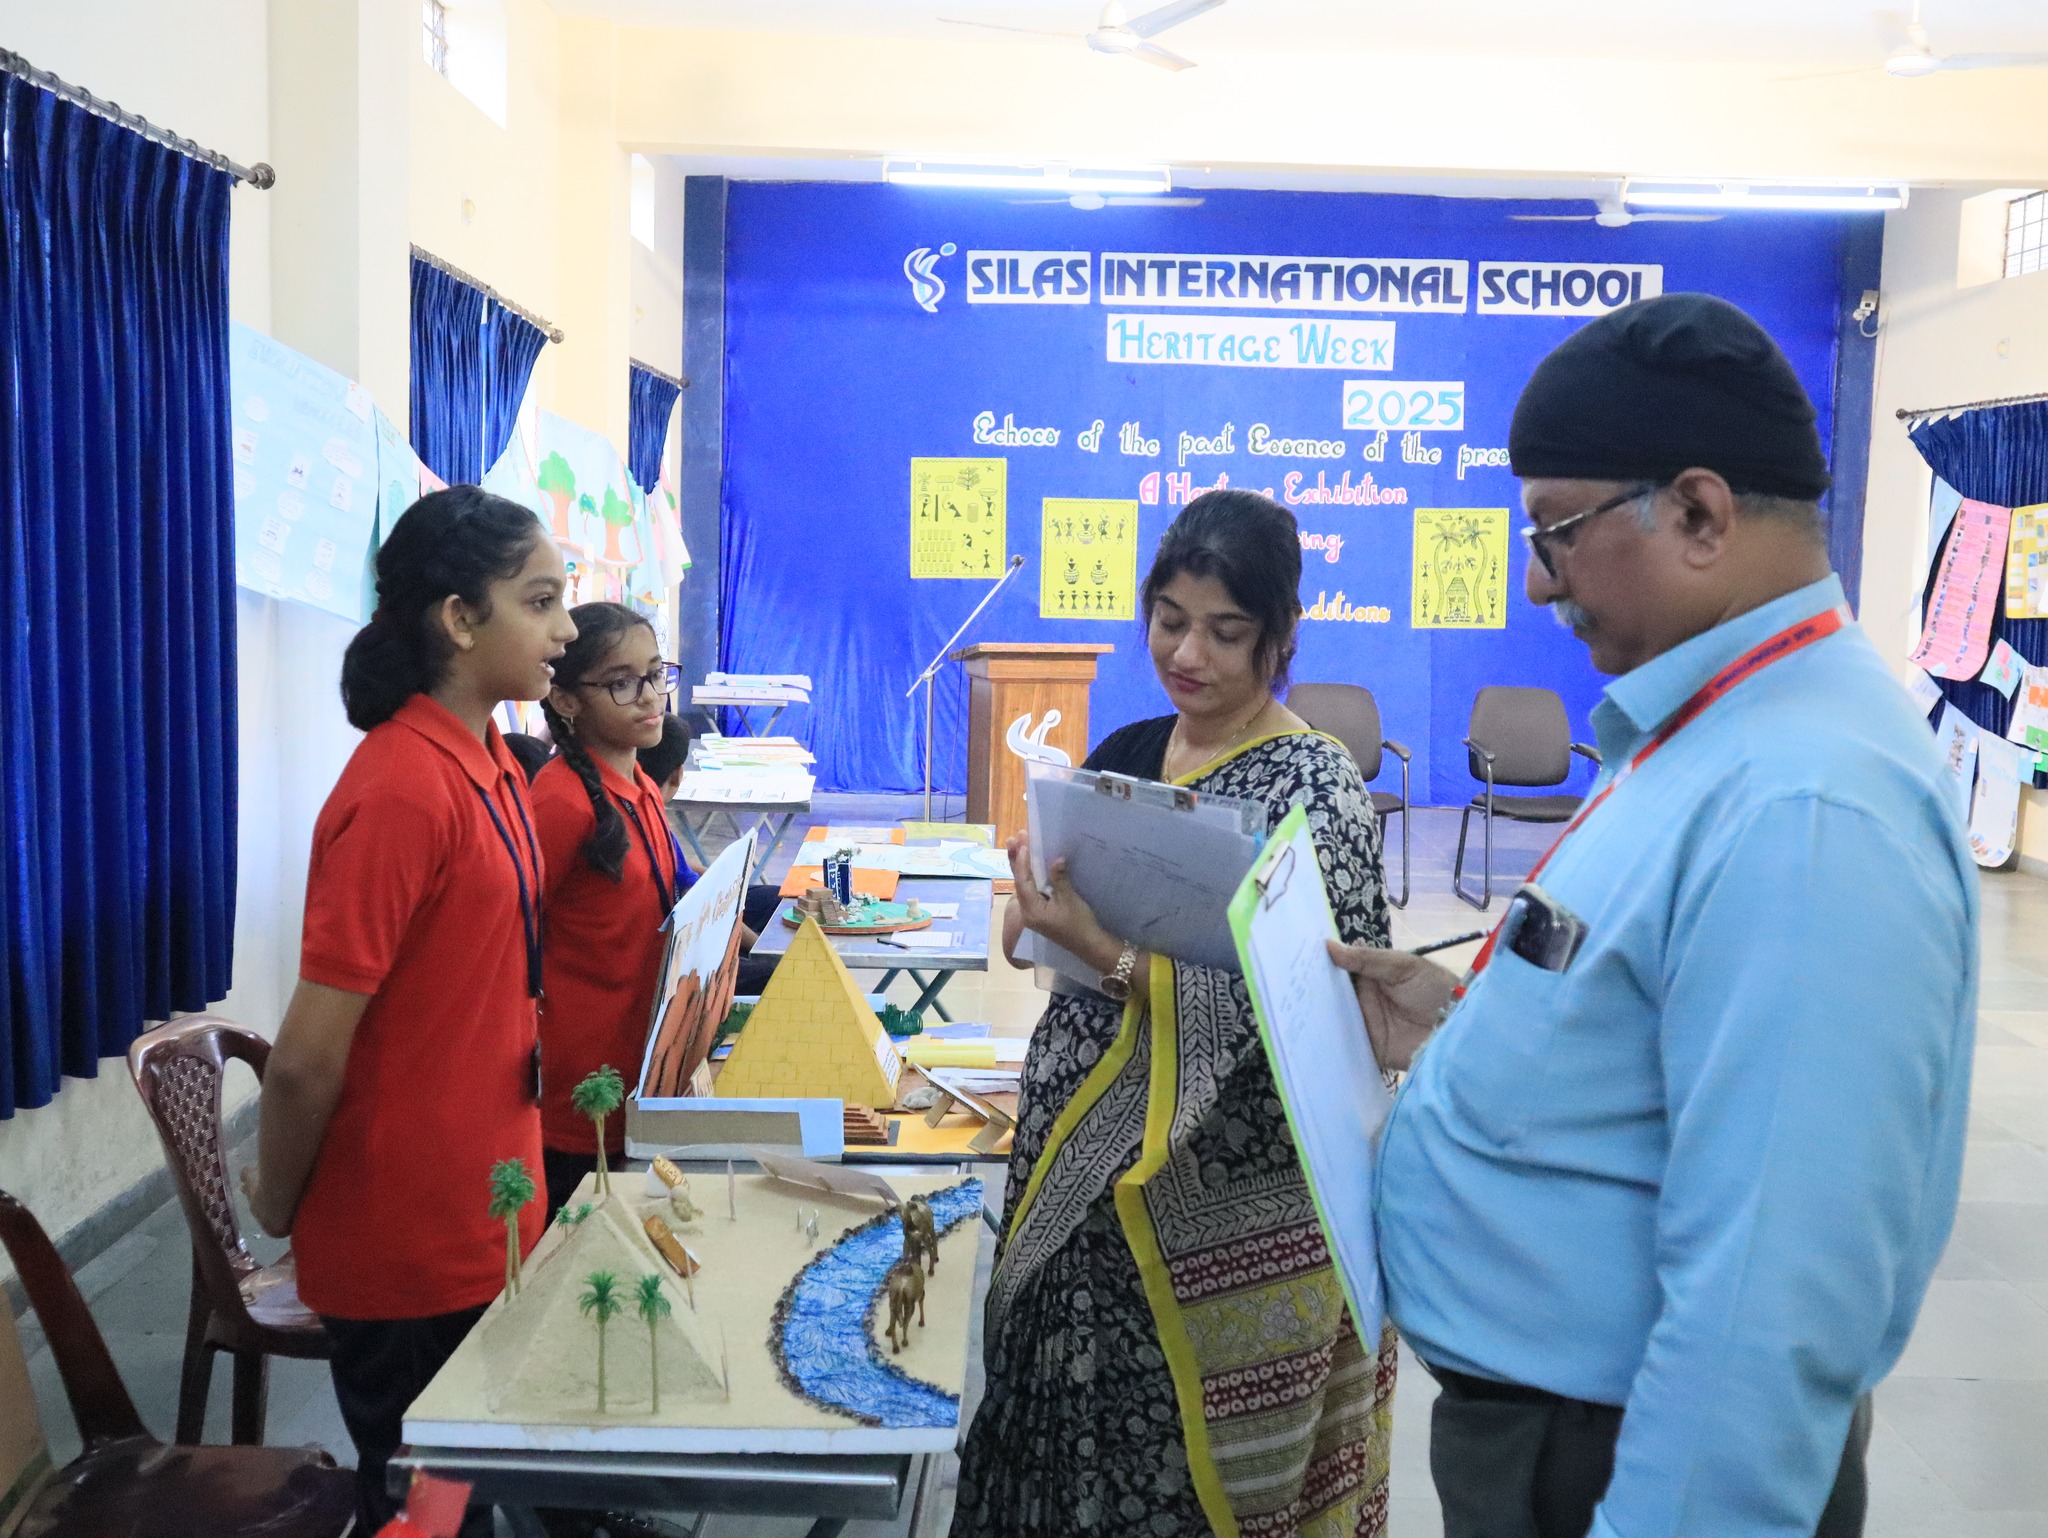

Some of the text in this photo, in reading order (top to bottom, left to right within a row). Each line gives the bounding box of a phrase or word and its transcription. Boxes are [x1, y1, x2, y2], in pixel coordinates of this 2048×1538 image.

[972, 258, 1089, 299] SILAS
[1104, 258, 1464, 307] INTERNATIONAL
[1347, 389, 1463, 426] 2025
[1079, 420, 1103, 451] of
[1120, 422, 1159, 455] the
[1180, 423, 1233, 465] past
[1249, 424, 1344, 456] Essence
[1365, 431, 1387, 460] of
[1402, 432, 1441, 464] the
[1459, 445, 1511, 479] pres
[1140, 472, 1160, 504] A
[1284, 471, 1407, 505] Exhibition
[1300, 591, 1390, 622] ditions
